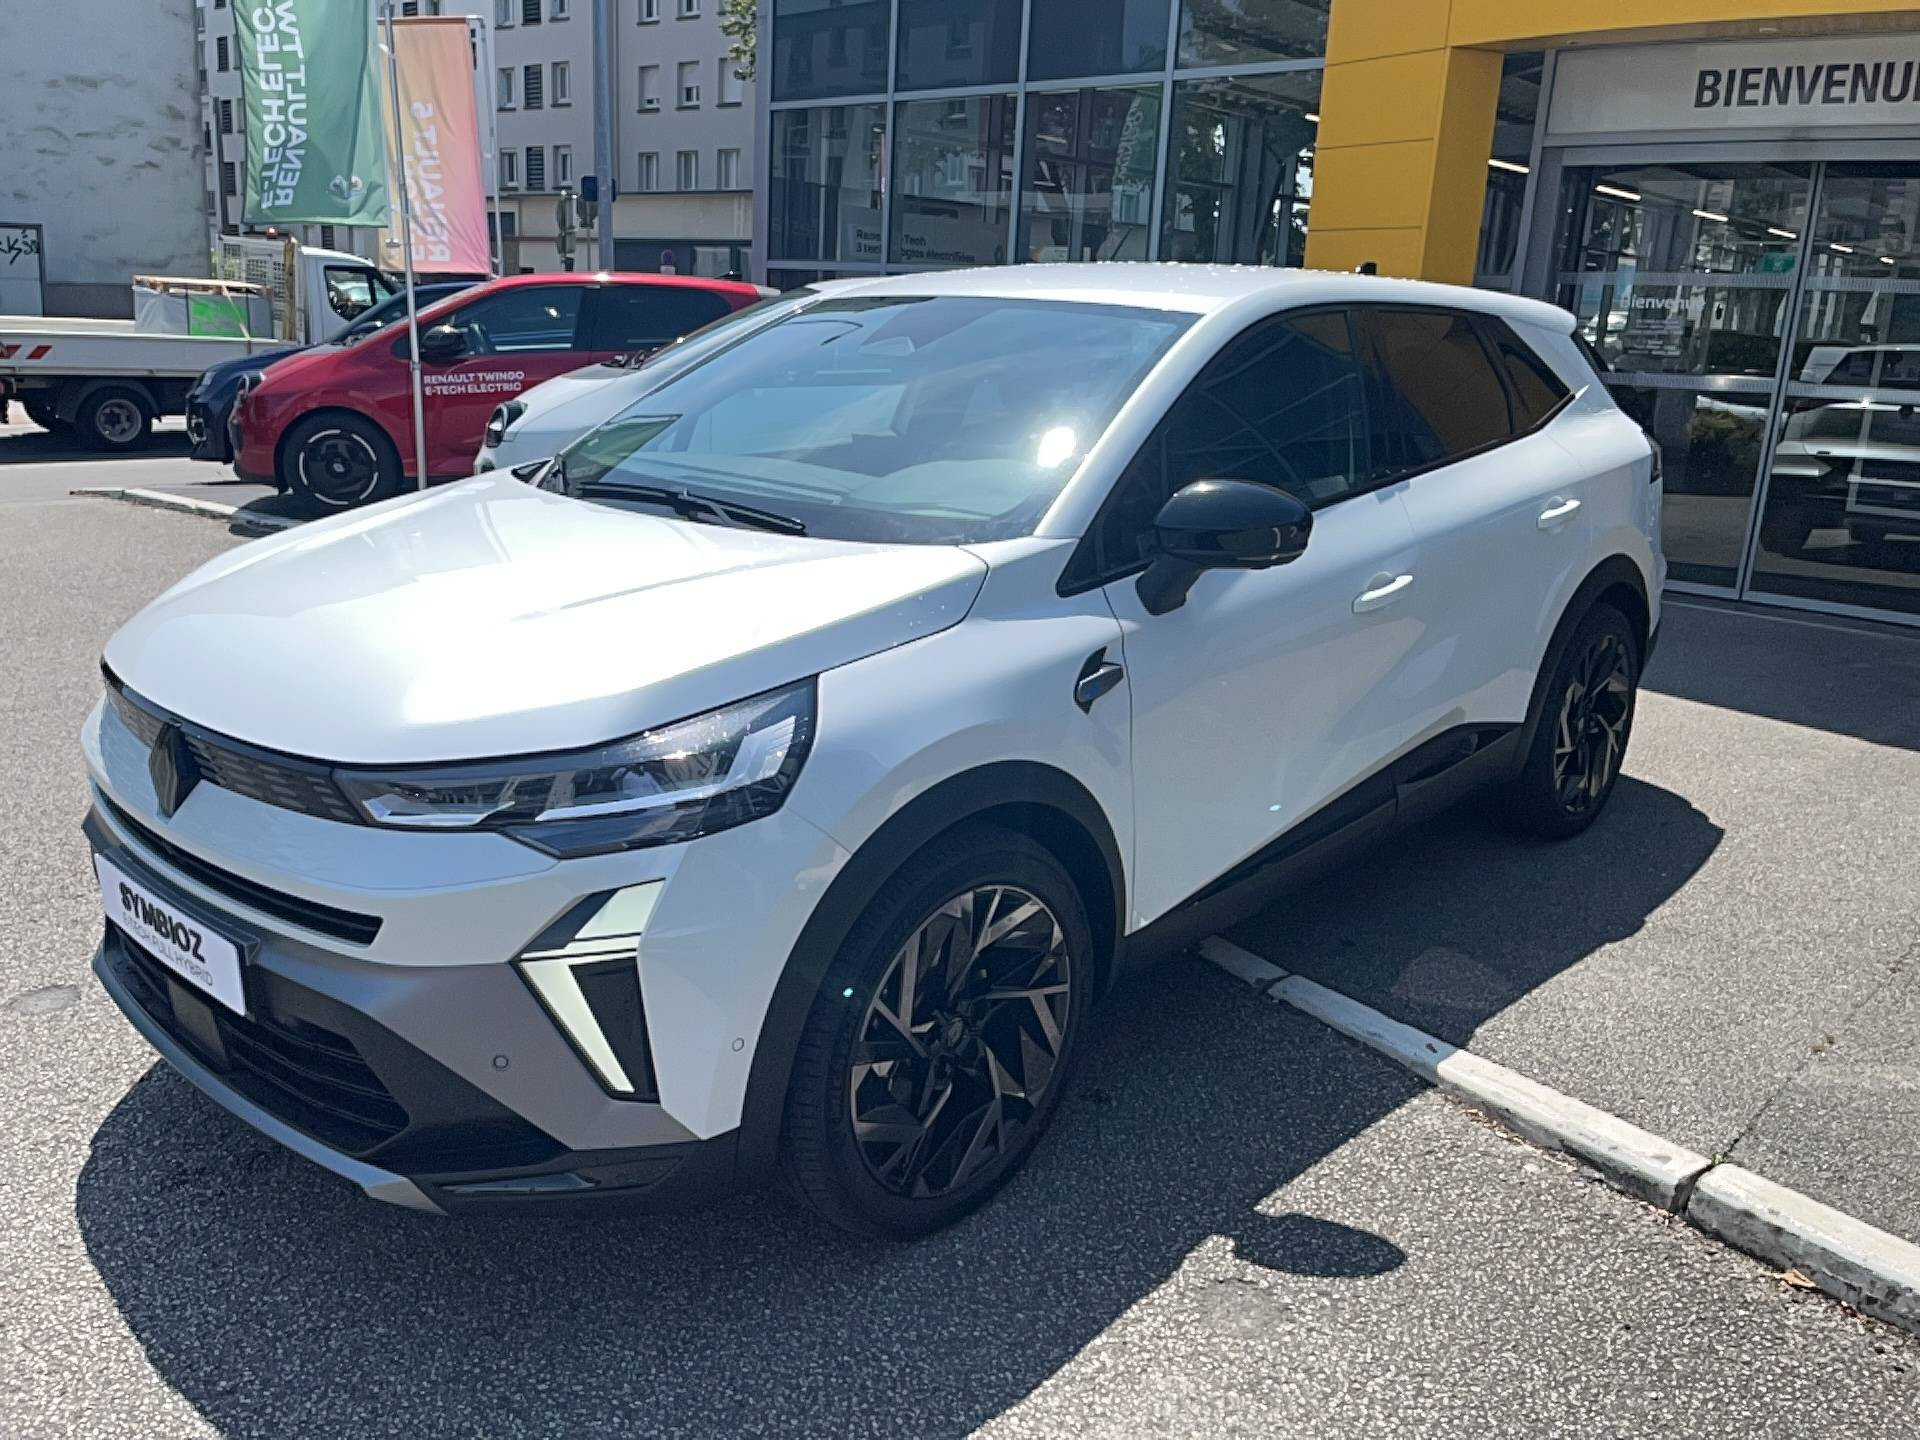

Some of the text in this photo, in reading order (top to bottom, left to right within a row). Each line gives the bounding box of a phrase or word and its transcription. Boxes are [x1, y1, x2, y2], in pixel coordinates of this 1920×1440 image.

[1694, 60, 1920, 108] BIENVENU
[424, 370, 525, 384] RENAULT TWINGO
[424, 382, 522, 396] E-TECH ELECTRIC
[119, 881, 207, 964] SYMBIOZ
[174, 950, 214, 987] HYBRID
